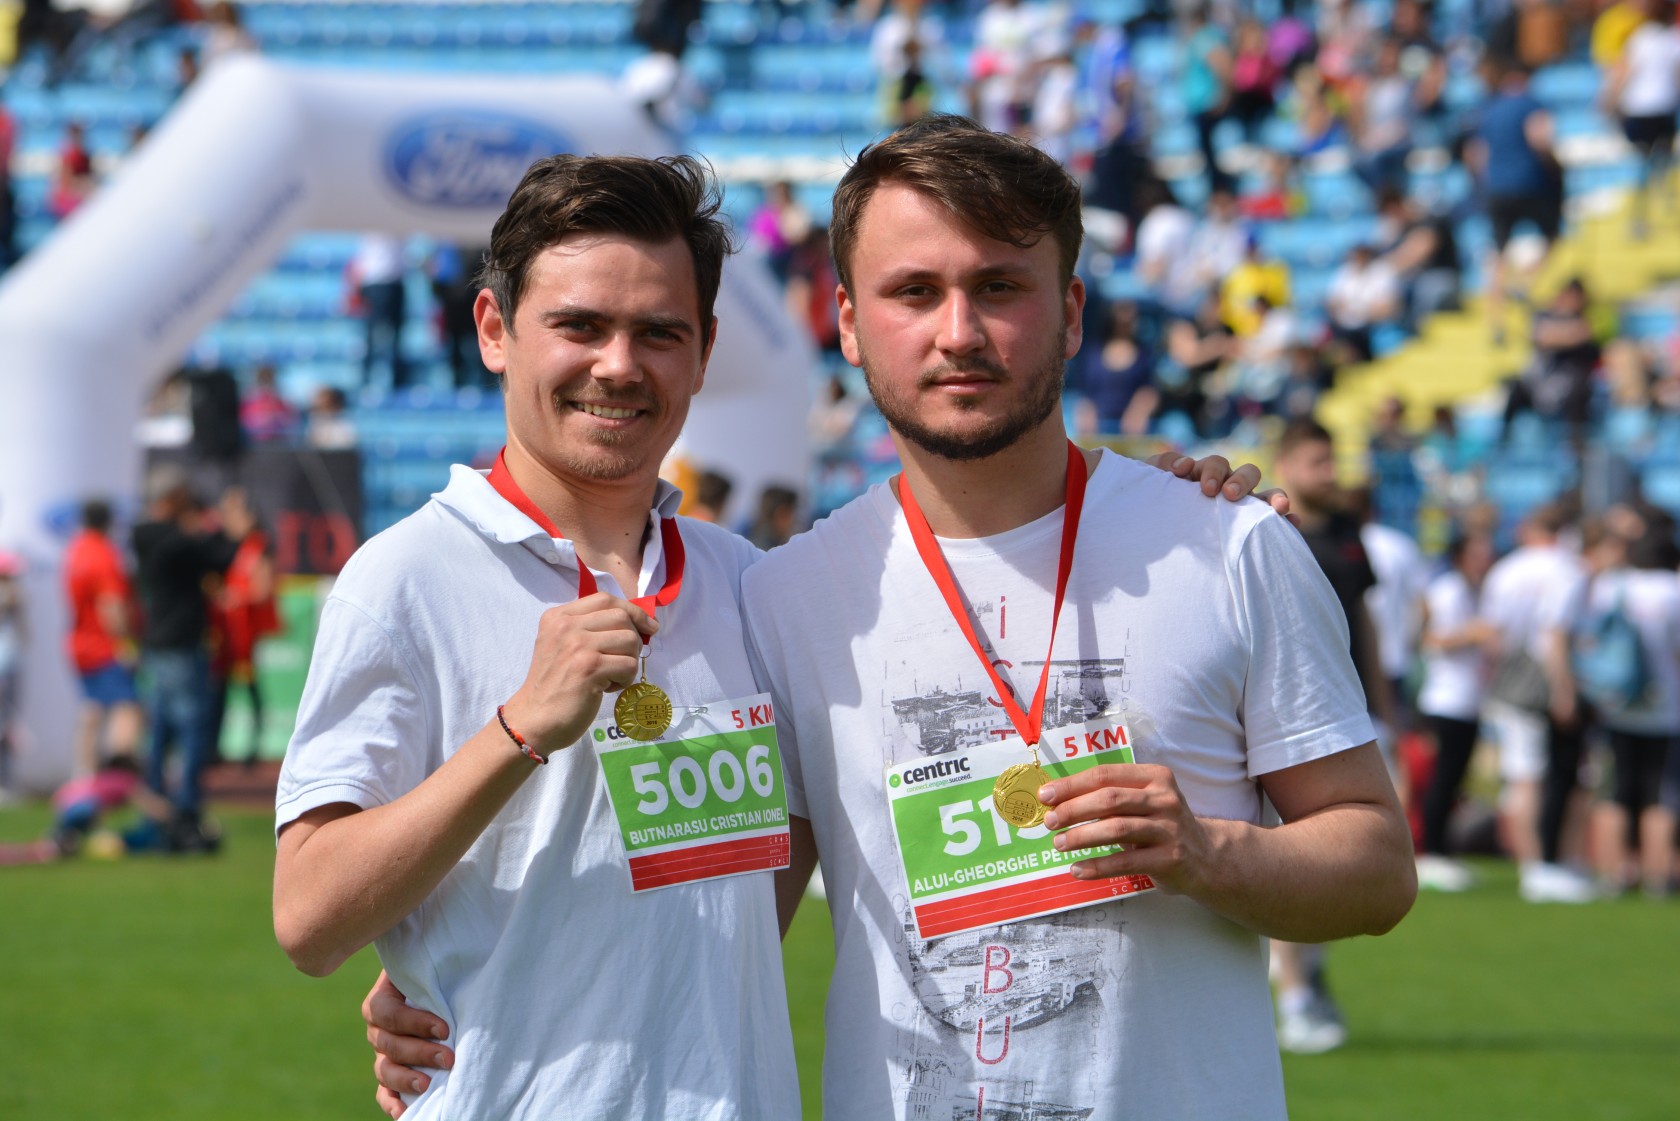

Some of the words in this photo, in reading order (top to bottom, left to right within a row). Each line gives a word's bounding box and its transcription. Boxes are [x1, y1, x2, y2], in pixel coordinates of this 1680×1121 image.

[731, 709, 745, 729] 5
[1064, 735, 1079, 758] 5
[1085, 725, 1128, 753] KM
[630, 744, 774, 816] 5006
[903, 757, 970, 784] centric
[629, 818, 709, 846] BUTNARASU
[709, 810, 762, 832] CRISTIAN
[762, 807, 786, 824] IONEL
[914, 851, 1040, 894] ALUI-GHEORGHE
